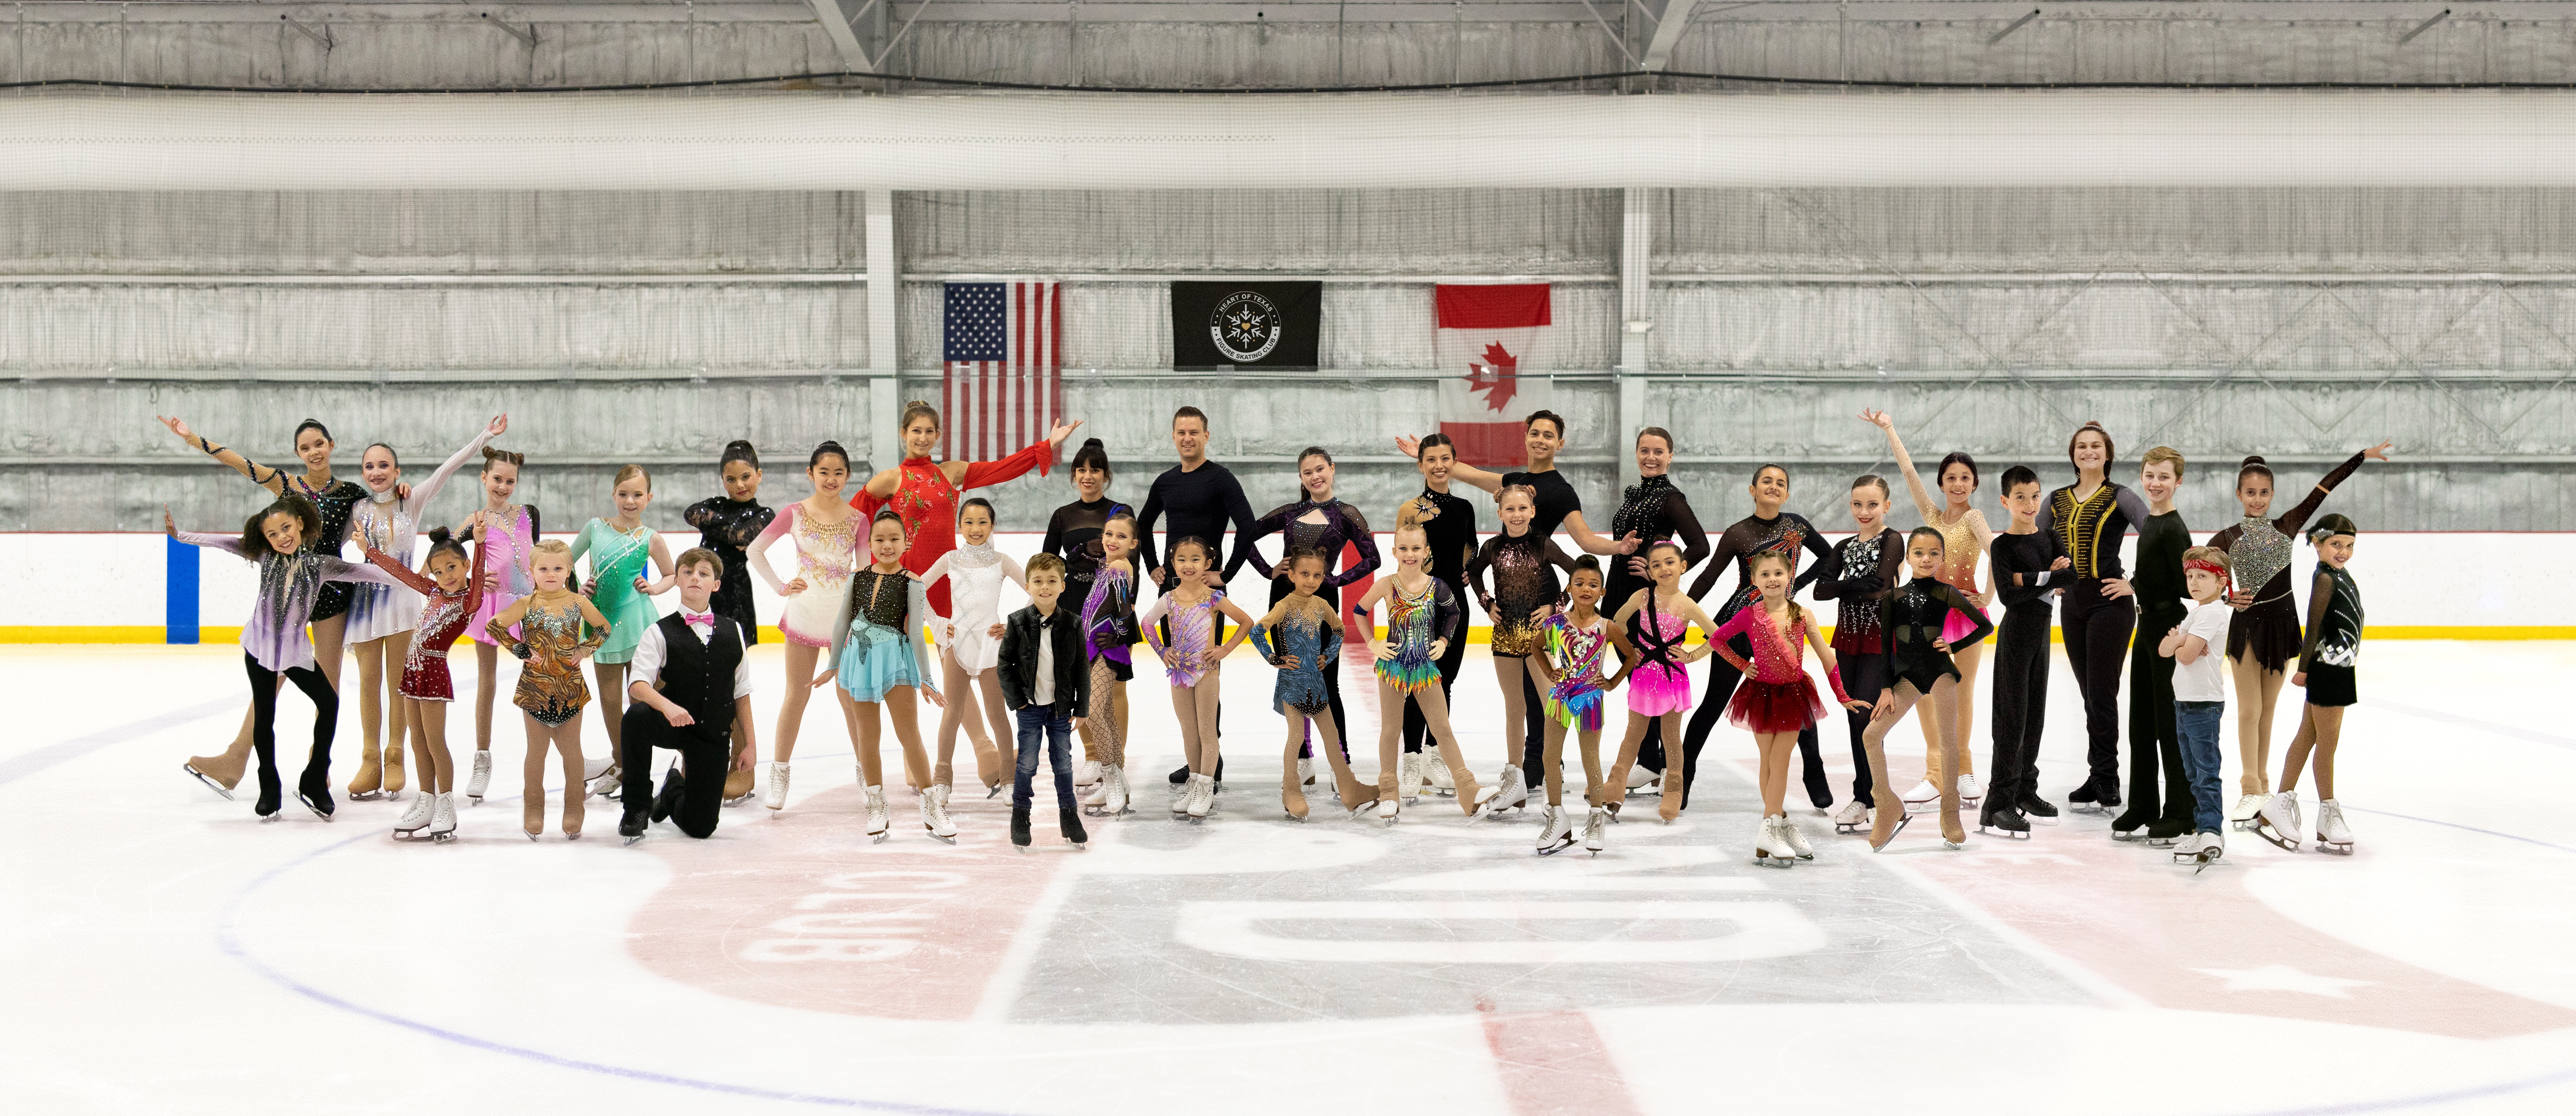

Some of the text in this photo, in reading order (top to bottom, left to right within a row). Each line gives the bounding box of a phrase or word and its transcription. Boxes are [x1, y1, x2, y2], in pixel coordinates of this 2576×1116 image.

[1219, 295, 1239, 312] HEART
[1253, 295, 1273, 312] TEXAS
[1216, 337, 1276, 360] FIGURE SKATING CLUB
[740, 870, 969, 962] CLUB
